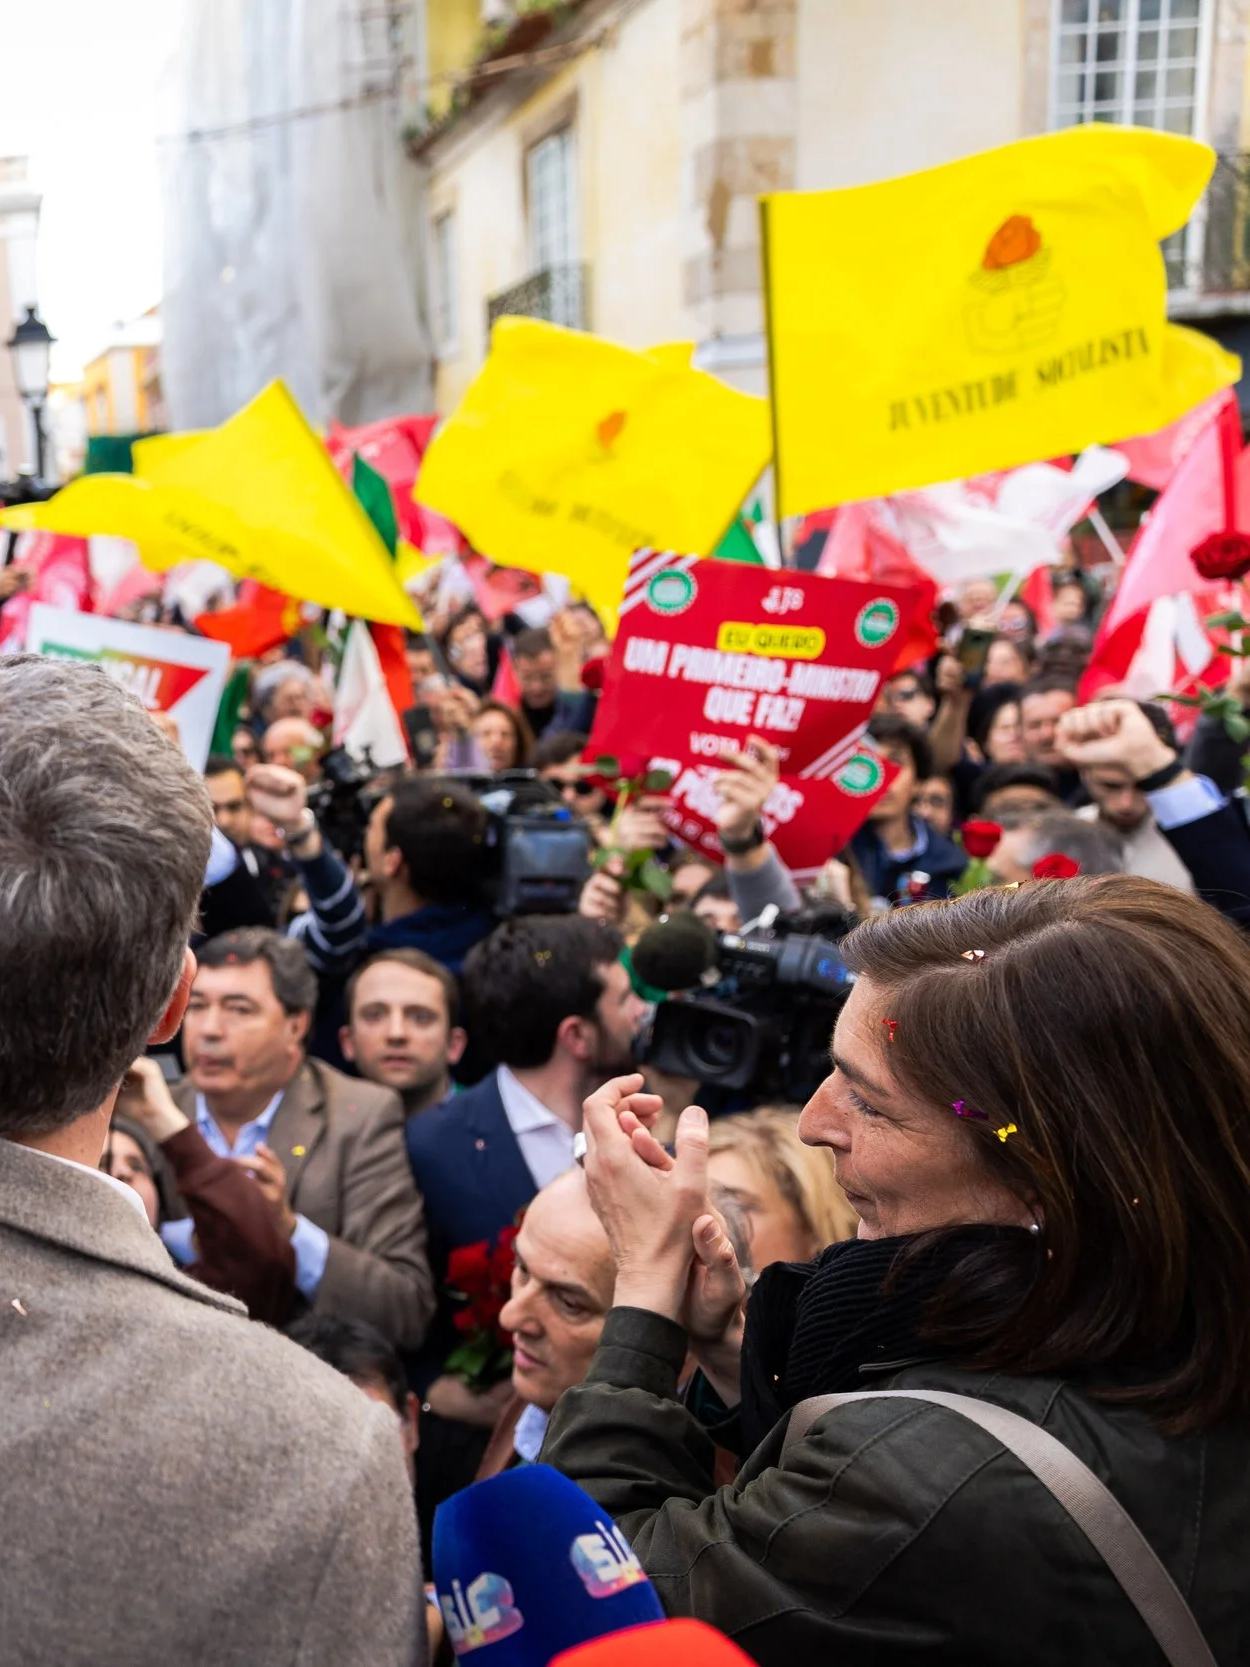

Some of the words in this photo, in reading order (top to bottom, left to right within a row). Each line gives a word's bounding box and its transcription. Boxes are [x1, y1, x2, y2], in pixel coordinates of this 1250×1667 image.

[624, 636, 670, 676] UM
[724, 629, 749, 647] EU
[703, 686, 756, 727] QUE
